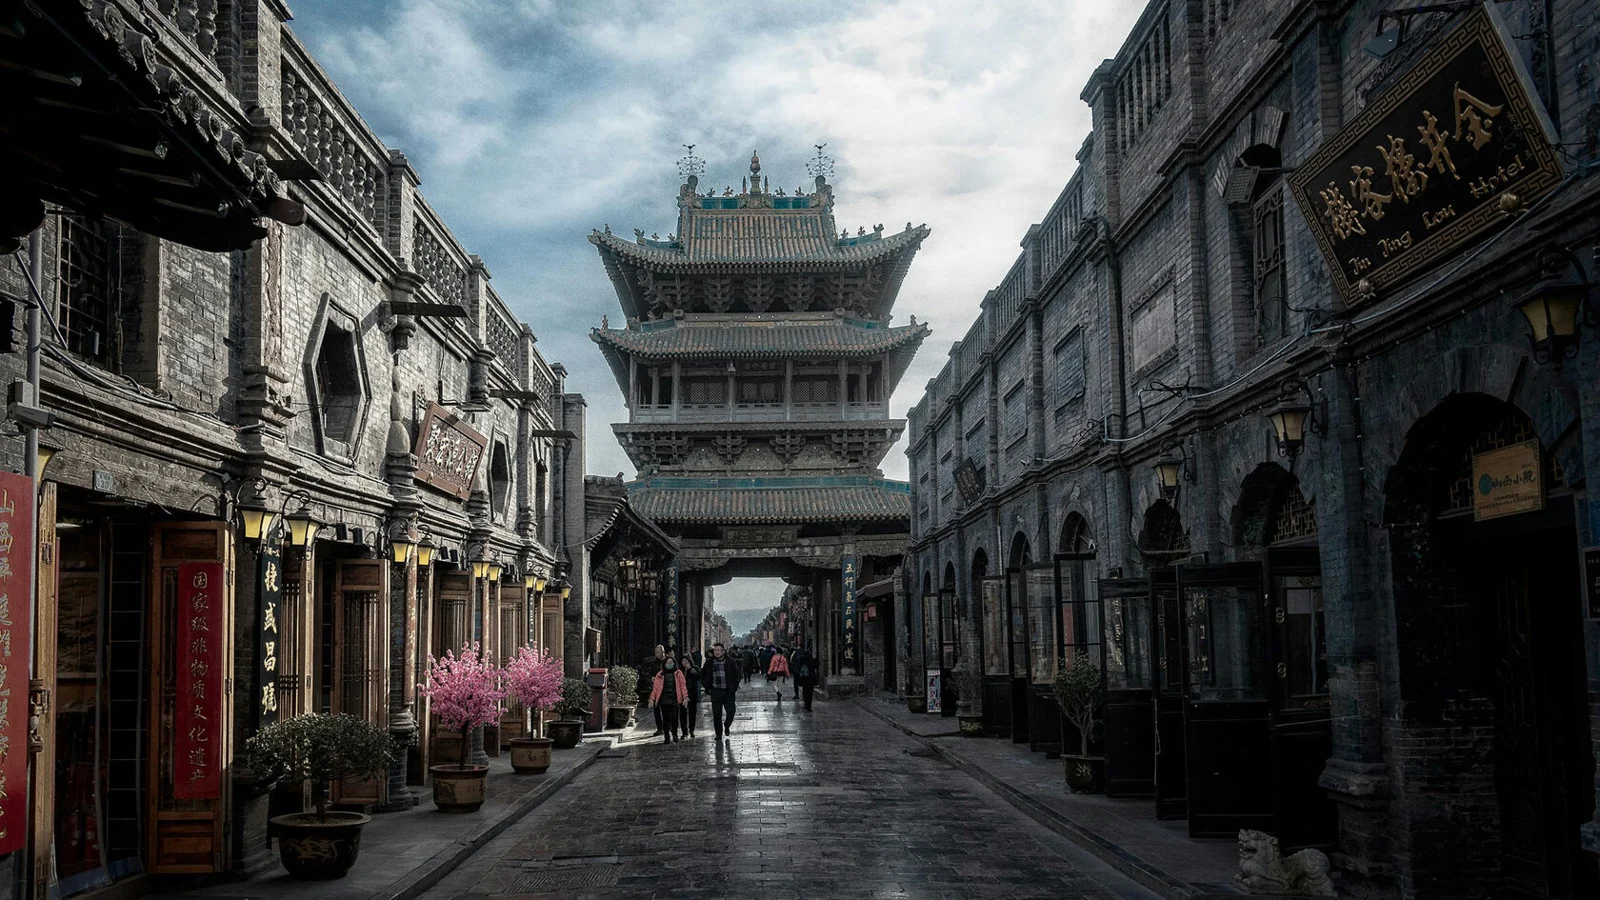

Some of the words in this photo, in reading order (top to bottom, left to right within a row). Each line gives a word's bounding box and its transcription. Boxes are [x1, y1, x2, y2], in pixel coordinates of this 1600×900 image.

[1377, 230, 1412, 257] Jing
[1422, 204, 1456, 230] Lou
[1469, 154, 1526, 199] Hotel
[188, 571, 209, 787] 国家级非物质文化遗产
